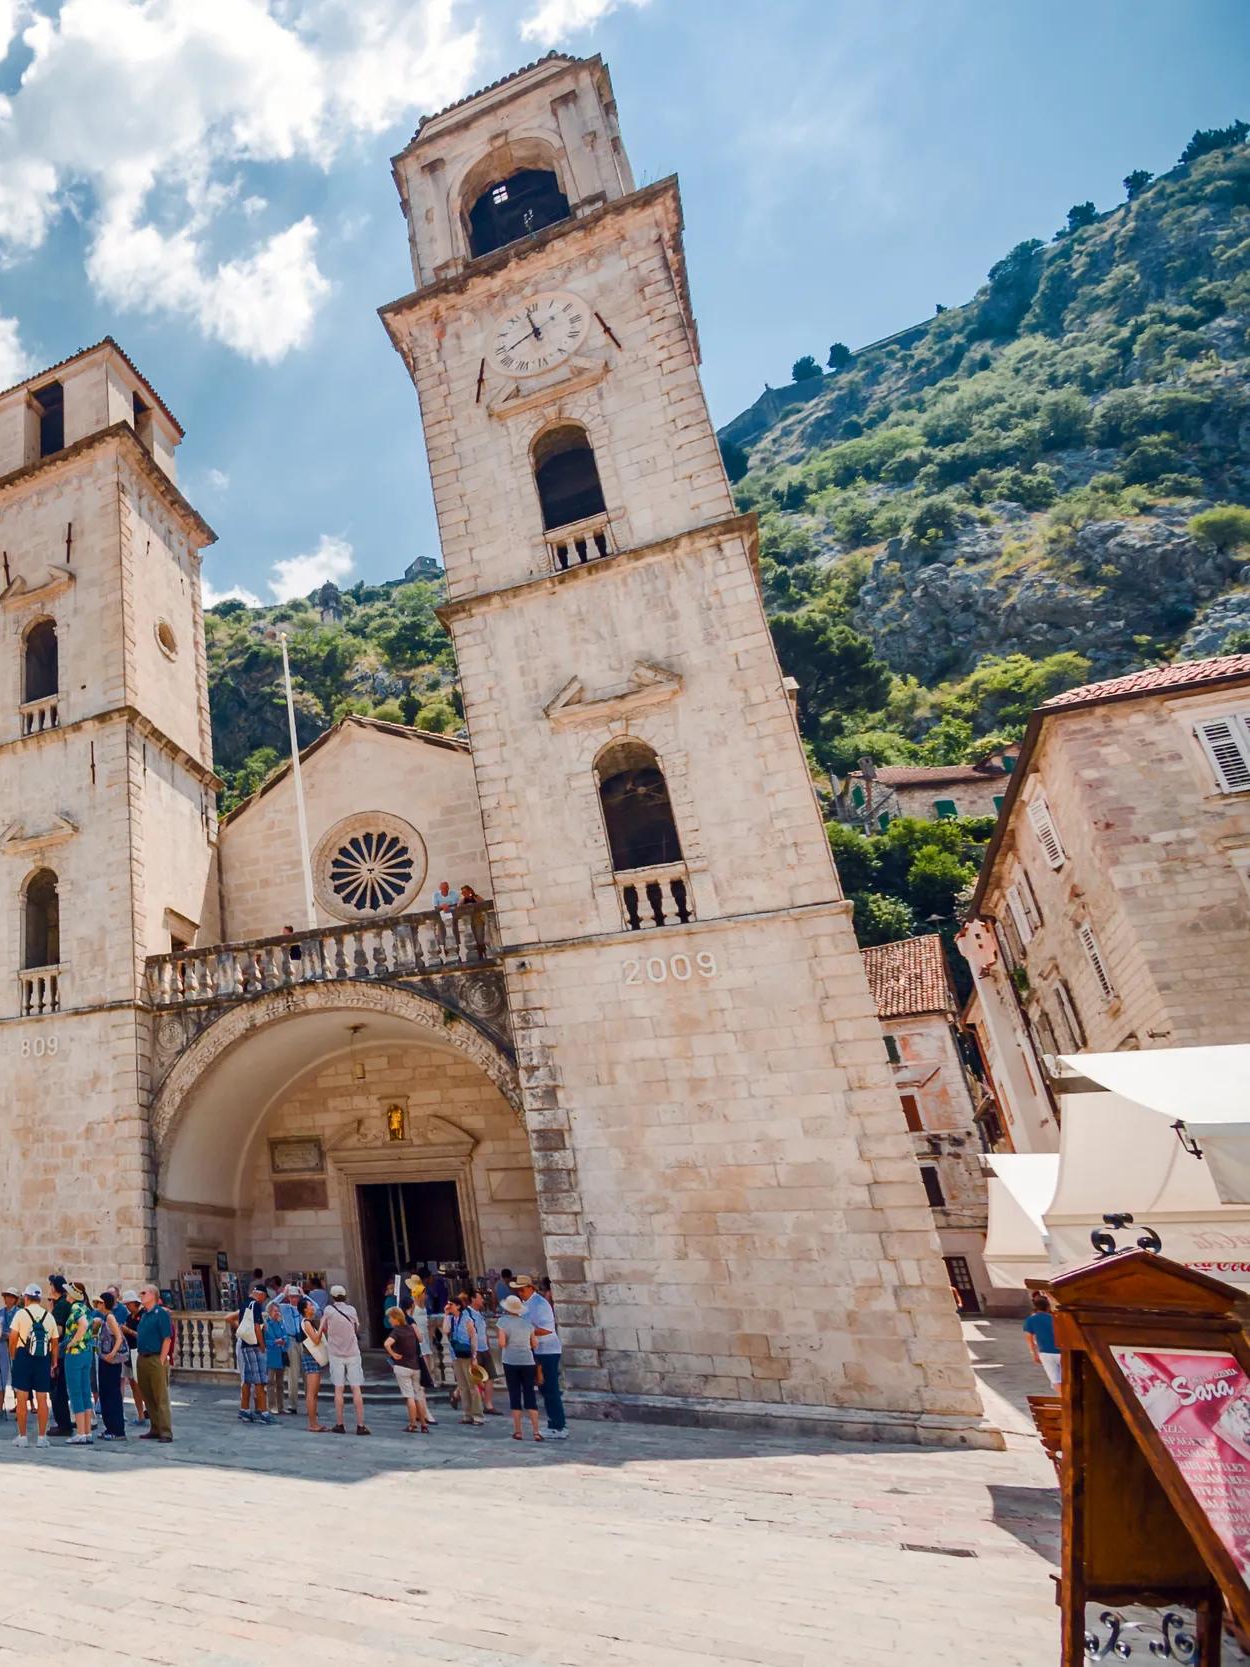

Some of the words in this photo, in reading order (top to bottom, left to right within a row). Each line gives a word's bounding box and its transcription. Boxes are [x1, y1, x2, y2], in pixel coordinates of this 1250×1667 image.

[622, 951, 718, 985] 2009
[21, 1036, 58, 1058] 809
[1171, 1376, 1235, 1406] Sara
